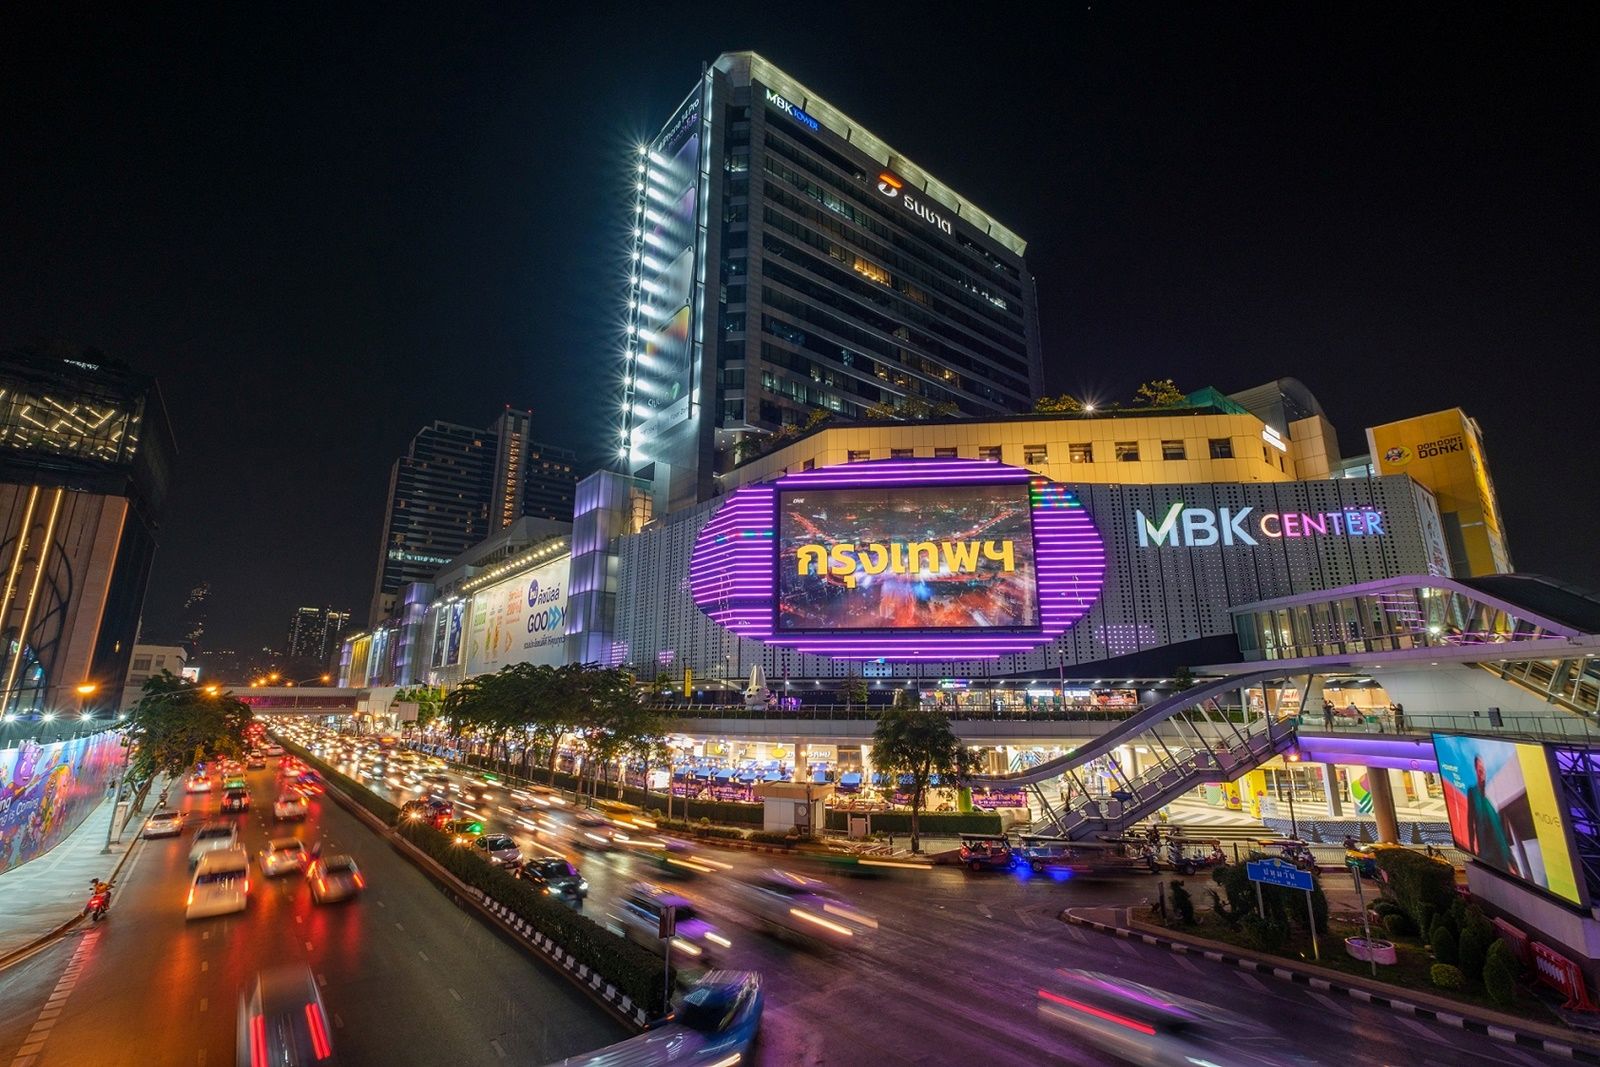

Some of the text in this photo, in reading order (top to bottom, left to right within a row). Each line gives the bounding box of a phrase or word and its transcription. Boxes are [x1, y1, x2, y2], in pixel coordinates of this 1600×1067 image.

[688, 98, 699, 115] Pro
[766, 88, 819, 131] MBK TOWER
[904, 194, 951, 235] ธนชาต
[1419, 442, 1464, 459] DONKI
[1136, 502, 1386, 547] MBK CENTER
[796, 540, 1016, 589] กรุงเทพฯ
